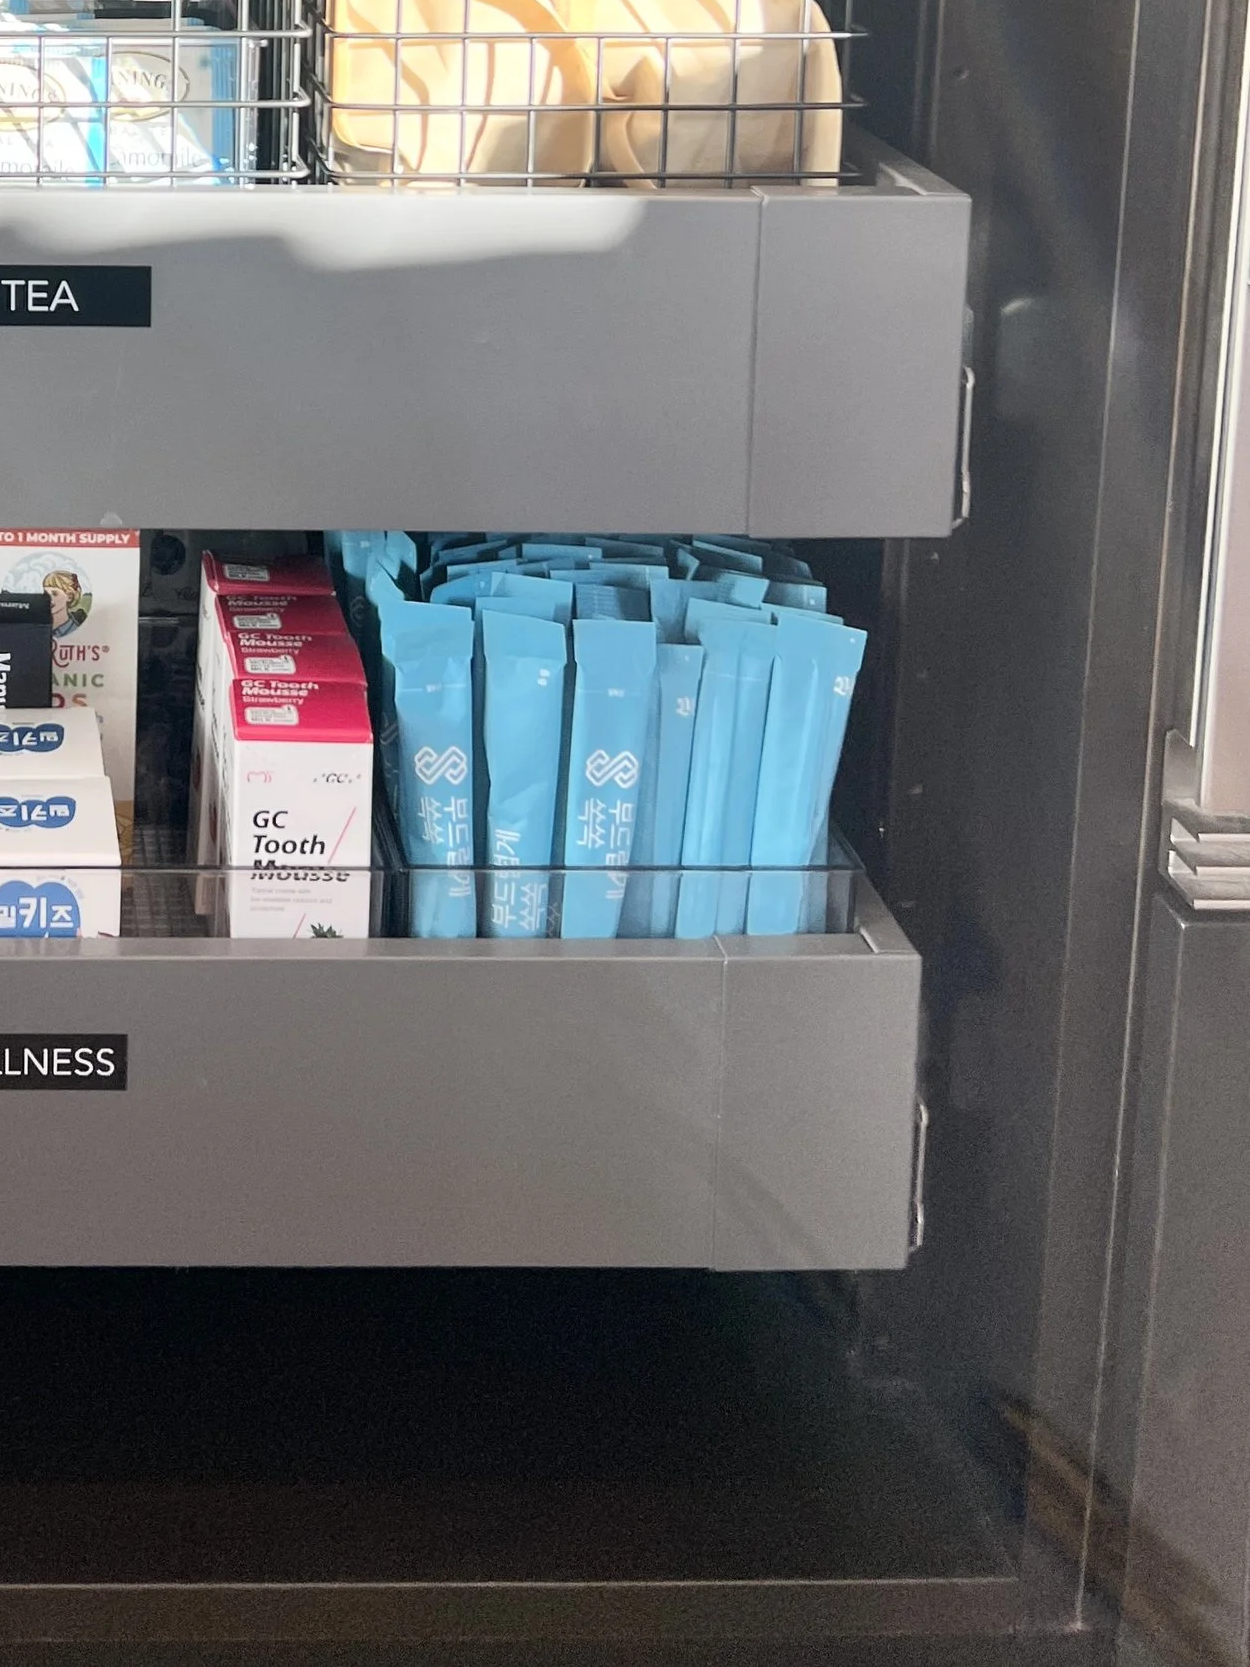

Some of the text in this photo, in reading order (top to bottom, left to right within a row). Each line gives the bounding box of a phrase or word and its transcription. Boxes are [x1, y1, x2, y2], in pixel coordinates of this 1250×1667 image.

[0, 279, 80, 312] TEA
[17, 532, 24, 543] 1
[26, 532, 76, 544] MONTH
[79, 533, 131, 545] SUPPLY
[239, 639, 304, 648] Mousse
[240, 646, 301, 655] Strawberry
[51, 673, 105, 688] ANIC
[240, 679, 320, 691] GC Tooth
[242, 687, 310, 698] Mousse
[242, 696, 305, 705] Strawberry
[252, 809, 289, 829] GC
[252, 834, 327, 855] Tooth
